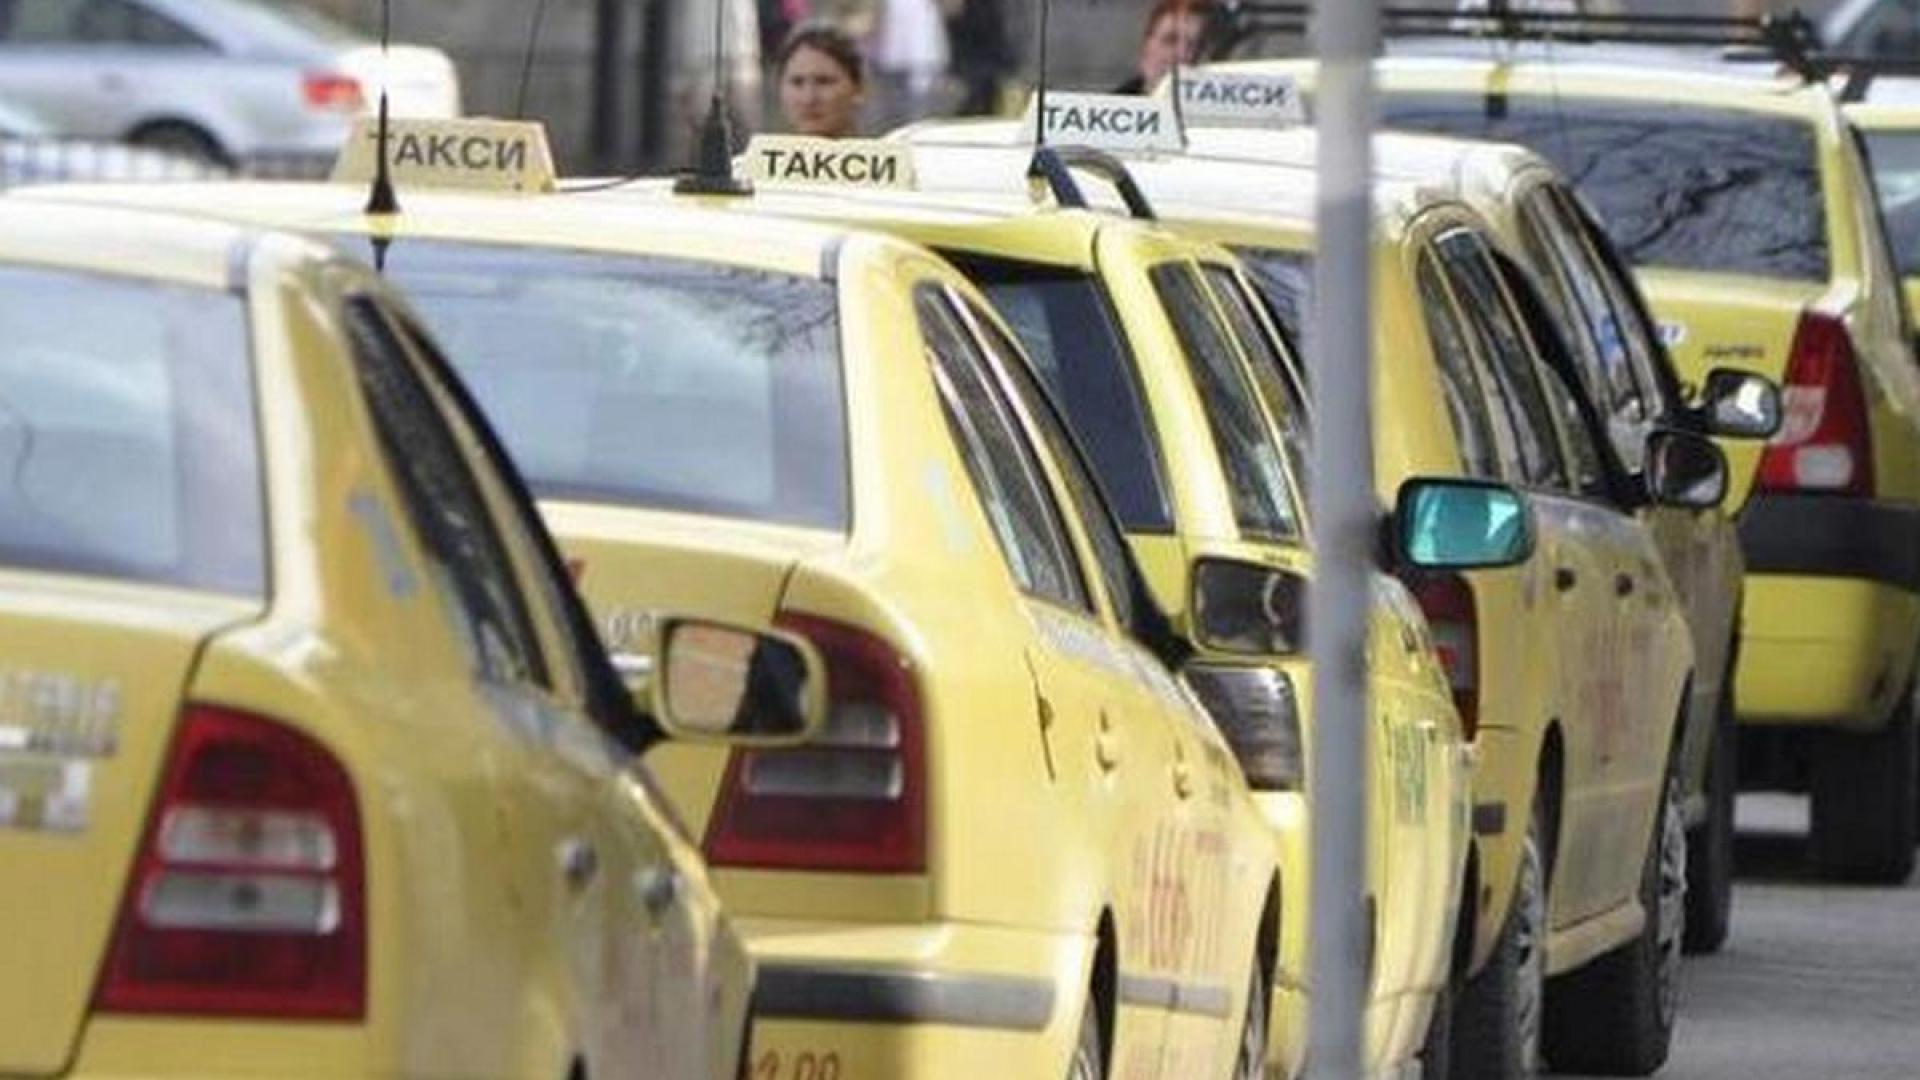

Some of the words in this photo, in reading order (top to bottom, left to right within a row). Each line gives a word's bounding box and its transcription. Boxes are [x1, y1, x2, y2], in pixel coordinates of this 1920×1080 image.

[1180, 79, 1287, 105] ТАКСИ
[1044, 105, 1160, 133] ТАКСИ
[761, 150, 897, 183] ТАКСИ
